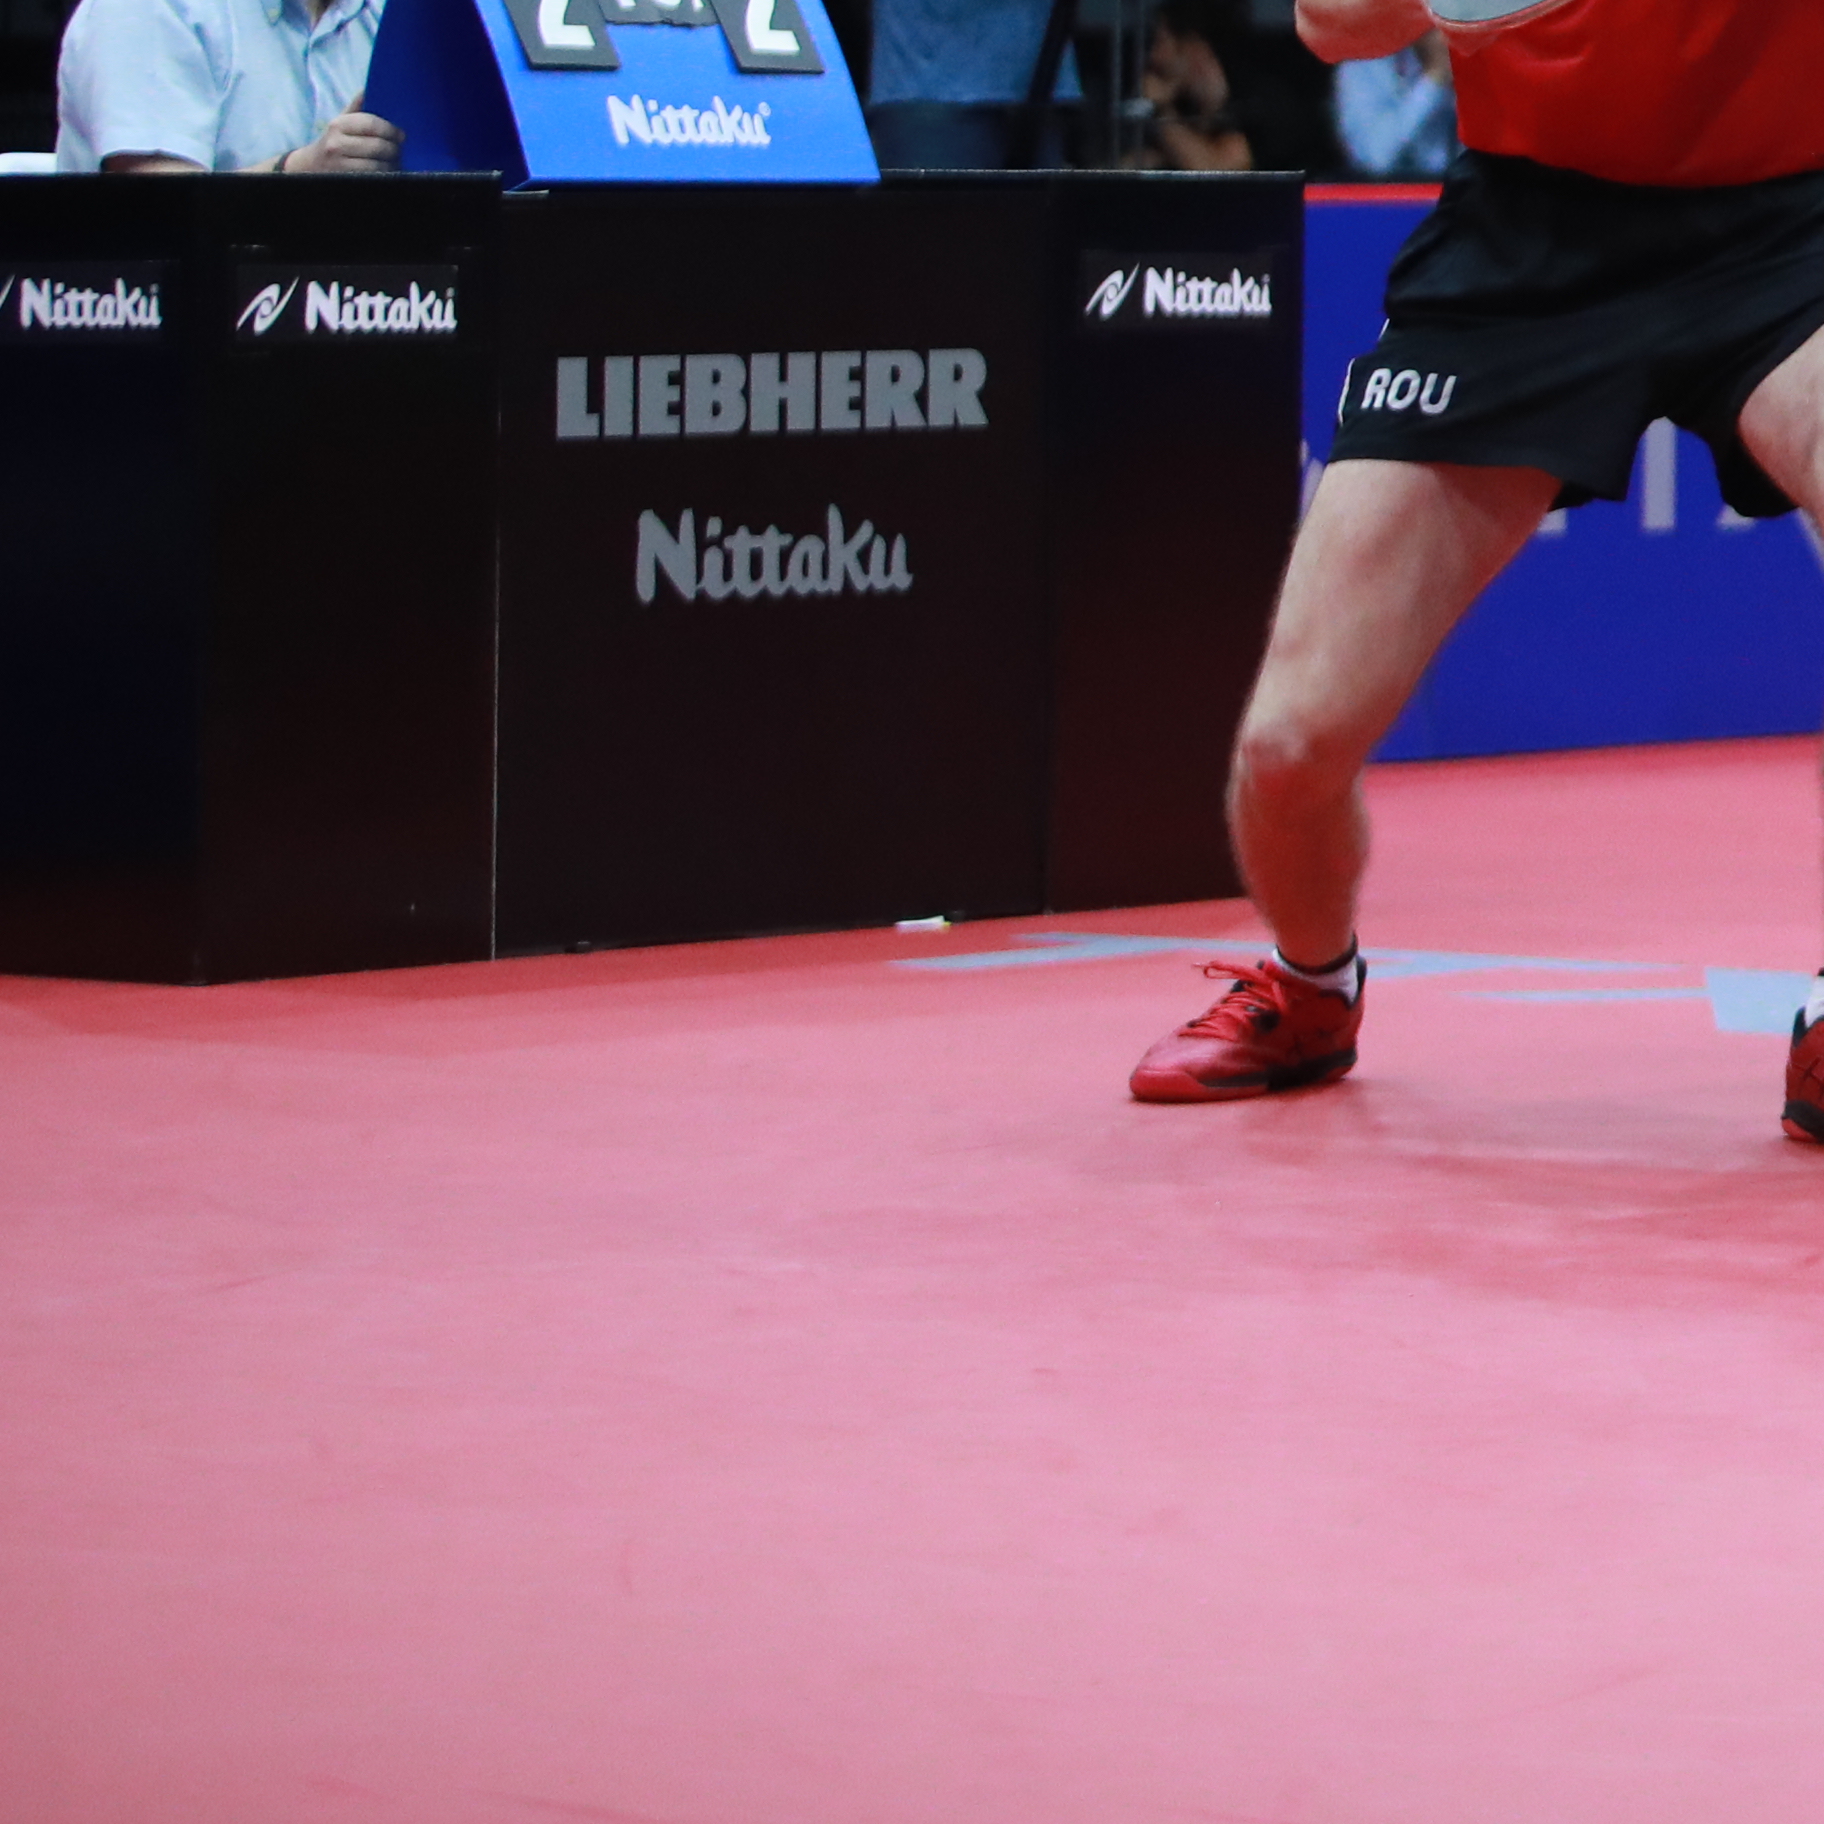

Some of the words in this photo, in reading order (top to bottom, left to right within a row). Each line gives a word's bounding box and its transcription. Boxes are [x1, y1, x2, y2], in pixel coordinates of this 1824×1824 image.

[606, 93, 772, 146] Nittaku
[20, 276, 162, 330] Nittaku
[304, 279, 458, 334] Nittaku
[1143, 266, 1272, 317] Nittaku
[555, 346, 989, 440] LIEBHERR
[1360, 366, 1458, 415] ROU
[635, 502, 913, 606] Nittaku
